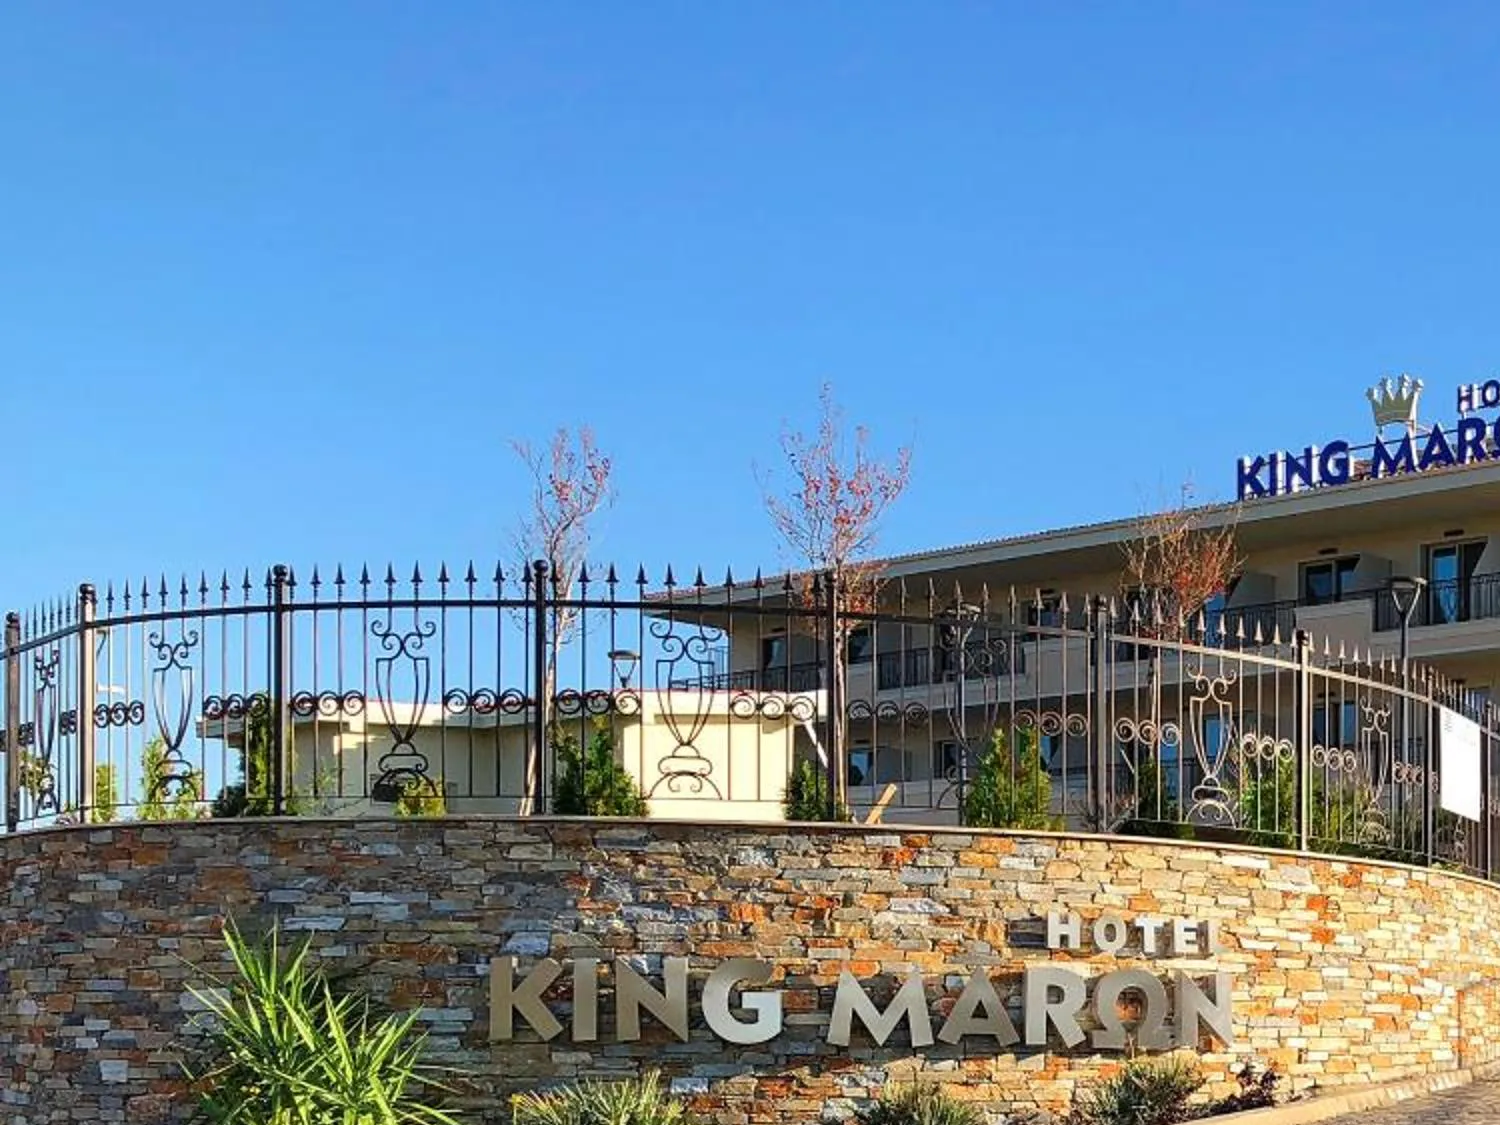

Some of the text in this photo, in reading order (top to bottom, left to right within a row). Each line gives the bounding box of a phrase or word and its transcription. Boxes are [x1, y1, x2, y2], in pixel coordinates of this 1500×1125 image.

[1237, 439, 1354, 501] KING
[1046, 912, 1229, 955] HOTEL
[489, 957, 783, 1044] KING
